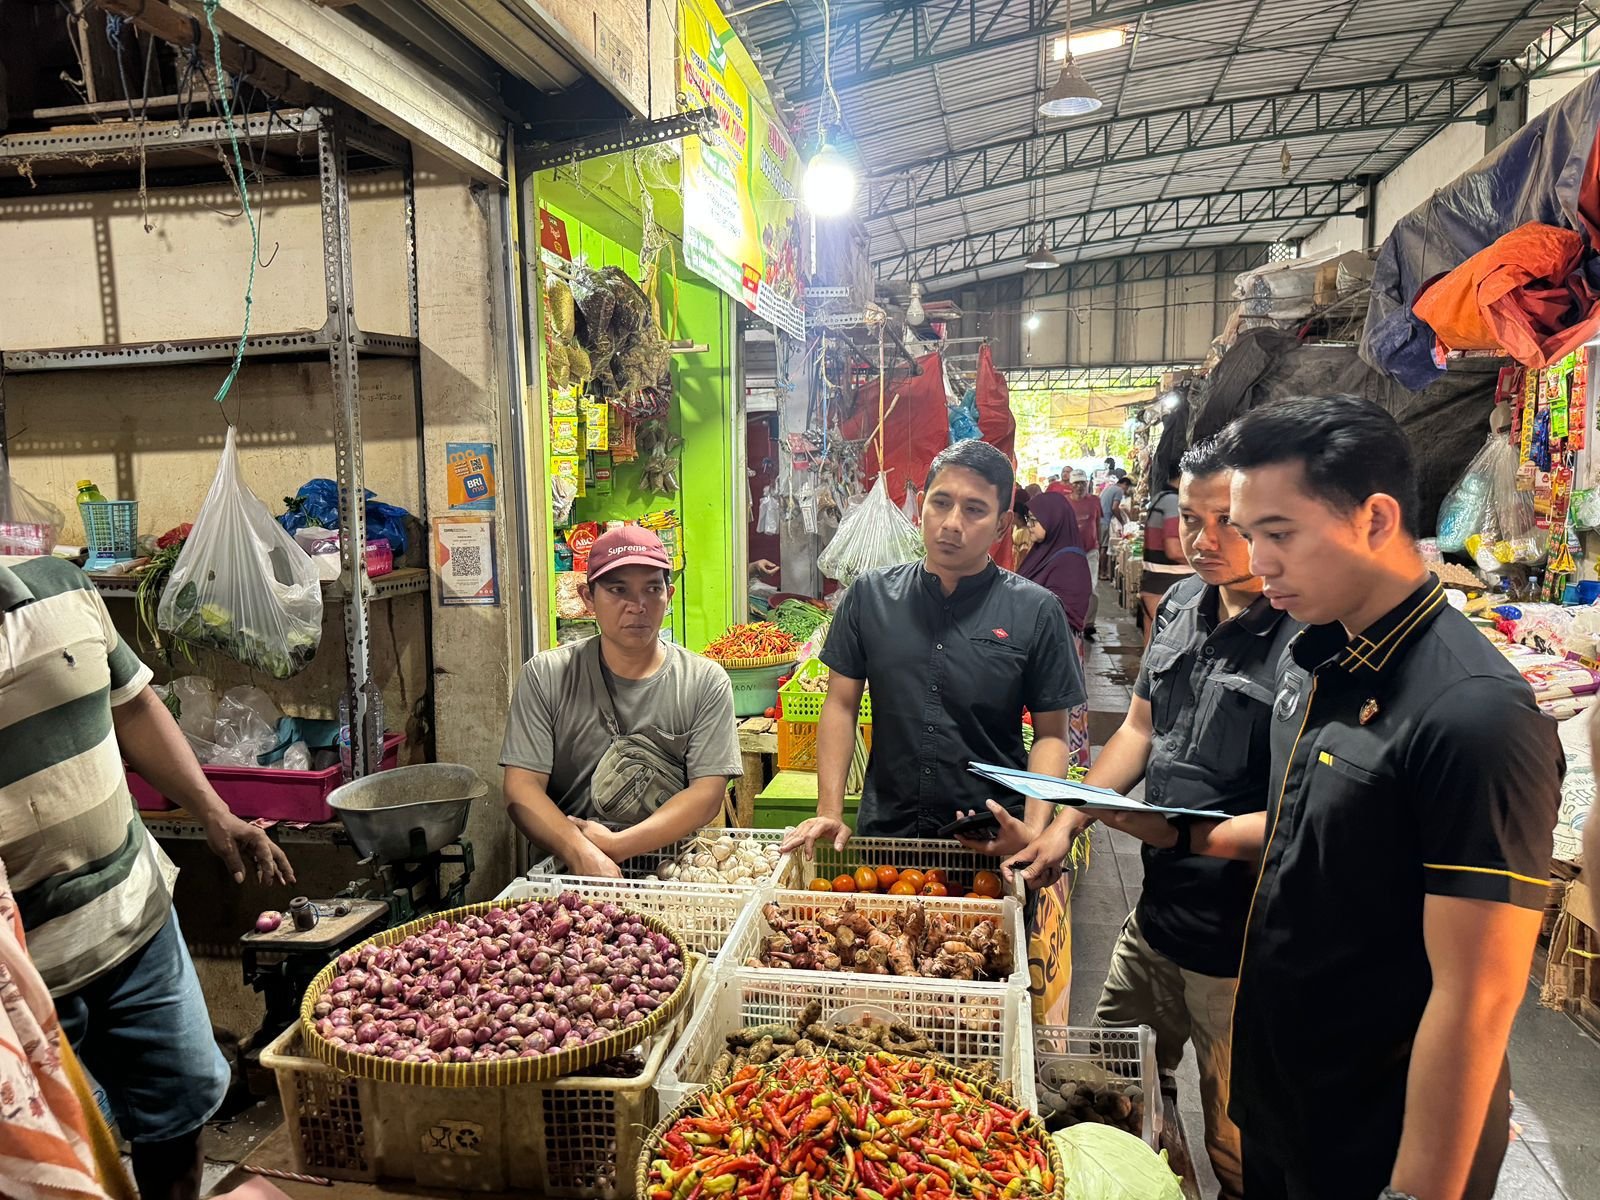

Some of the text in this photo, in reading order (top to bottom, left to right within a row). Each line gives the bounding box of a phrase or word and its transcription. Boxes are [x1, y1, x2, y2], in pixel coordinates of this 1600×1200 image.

[467, 477, 483, 489] BRI
[575, 537, 594, 547] ABC
[608, 545, 647, 557] Supreme
